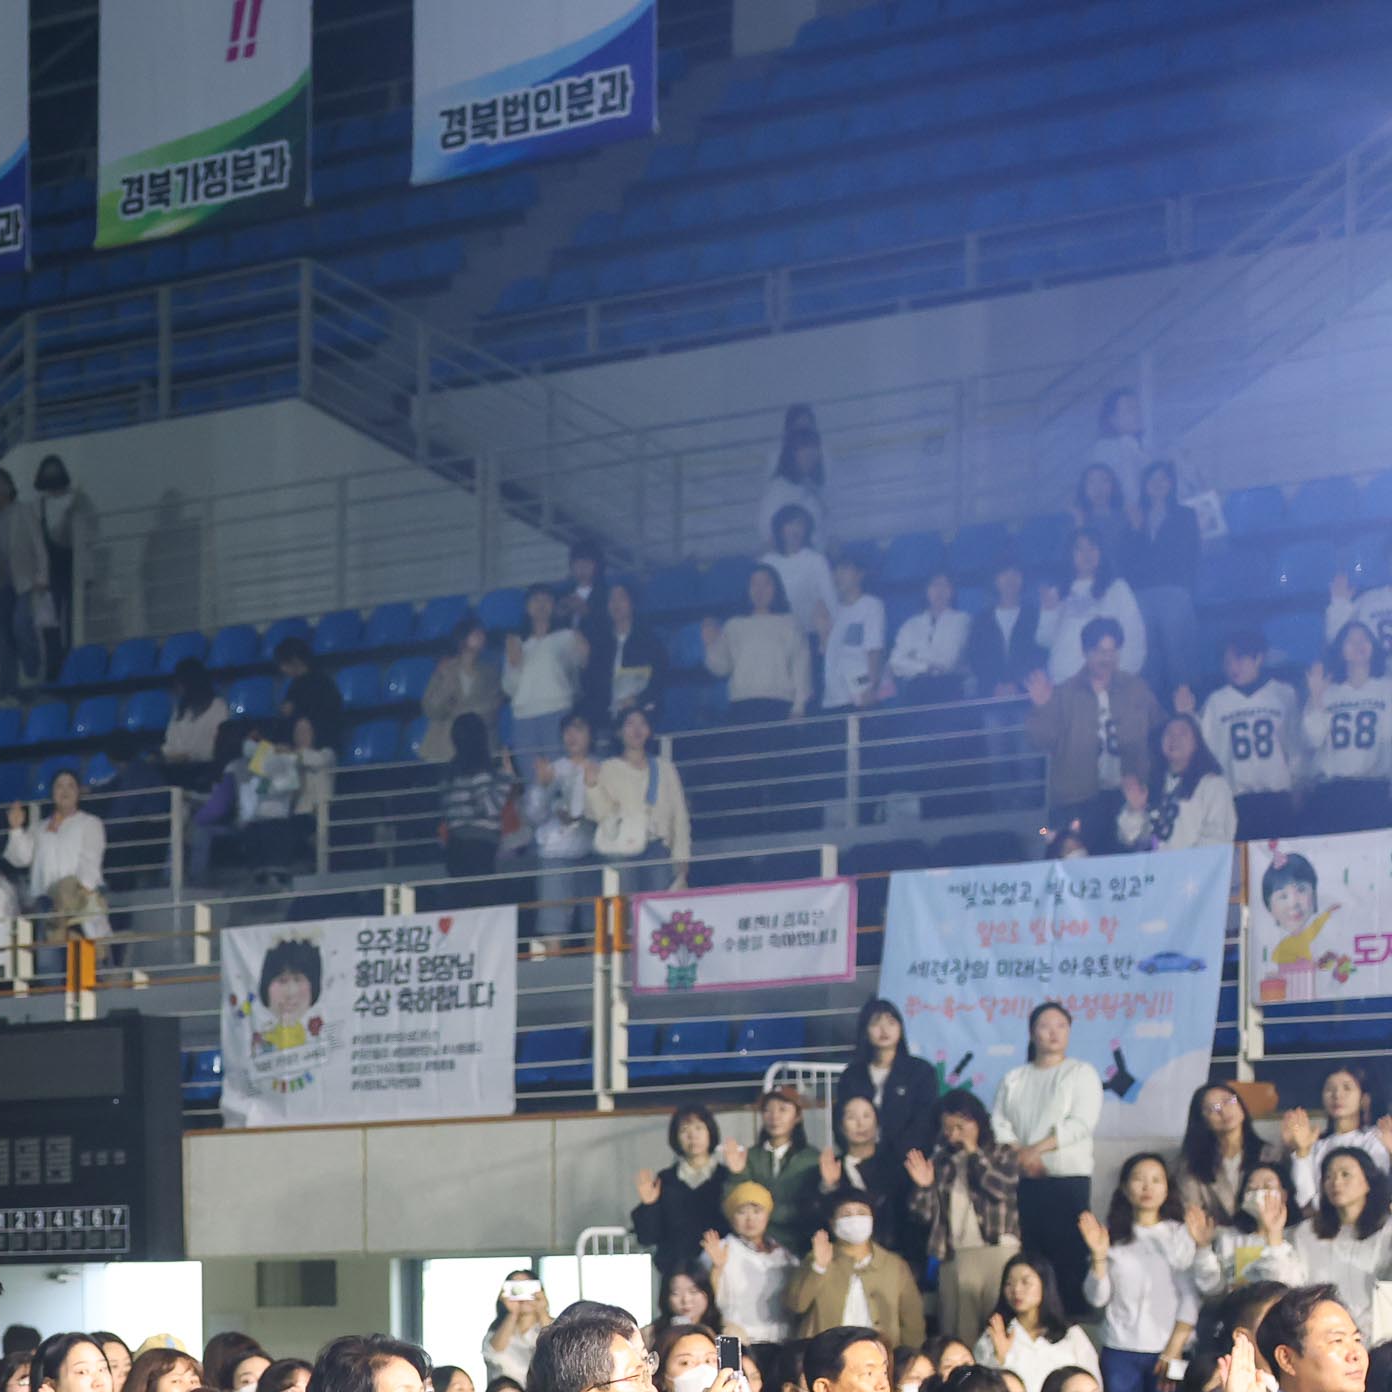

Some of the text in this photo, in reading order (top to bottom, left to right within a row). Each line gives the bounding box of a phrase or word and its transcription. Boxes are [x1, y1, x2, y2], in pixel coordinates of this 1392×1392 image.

[438, 69, 630, 151] 경북법인분과
[120, 146, 288, 216] 경북가정분과
[1230, 719, 1275, 761] 68
[1329, 710, 1378, 749] 68
[356, 925, 433, 954] 우주최강
[417, 952, 475, 984] 원장님
[996, 954, 1055, 984] 미래는
[1057, 952, 1137, 981] 아우토반
[352, 981, 496, 1018] 수상 축하합니다
